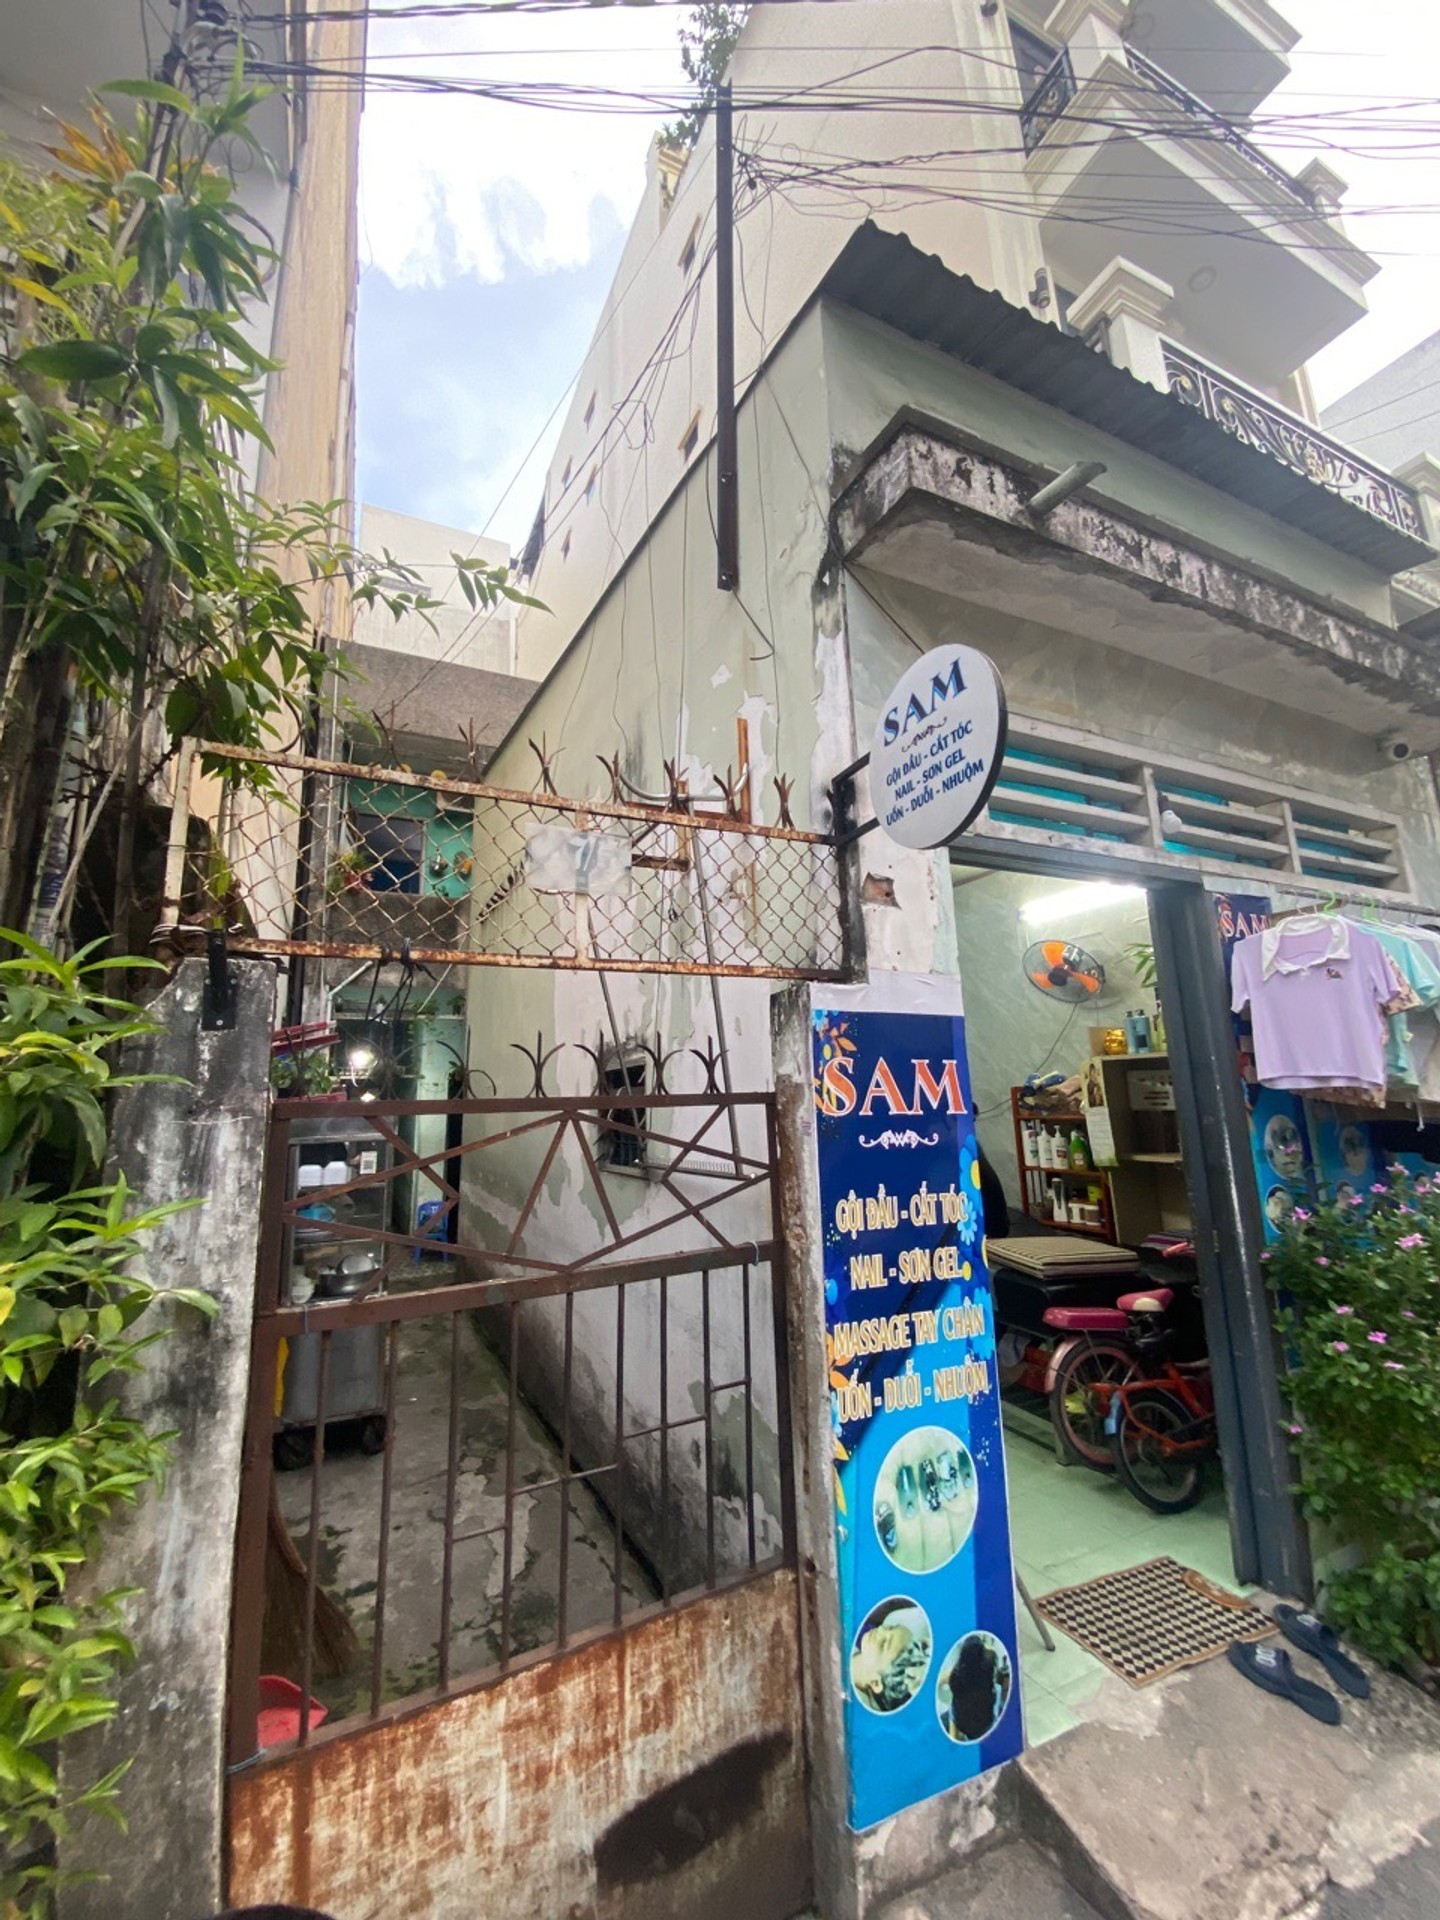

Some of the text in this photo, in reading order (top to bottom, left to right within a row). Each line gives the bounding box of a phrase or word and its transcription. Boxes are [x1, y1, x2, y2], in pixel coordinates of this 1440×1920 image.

[884, 657, 967, 747] SAM
[951, 720, 973, 744] TÓC
[894, 780, 915, 801] NAIL
[944, 748, 966, 770] GEL
[1221, 911, 1271, 938] SAM
[822, 1056, 968, 1117] SAM
[835, 1189, 864, 1240] GỘI
[909, 1180, 937, 1226] CẮT
[940, 1183, 968, 1224] TÓC
[850, 1252, 888, 1291] NAIL
[933, 1246, 963, 1281] GEL
[833, 1296, 986, 1360] MASSAGE TAY CHÂN
